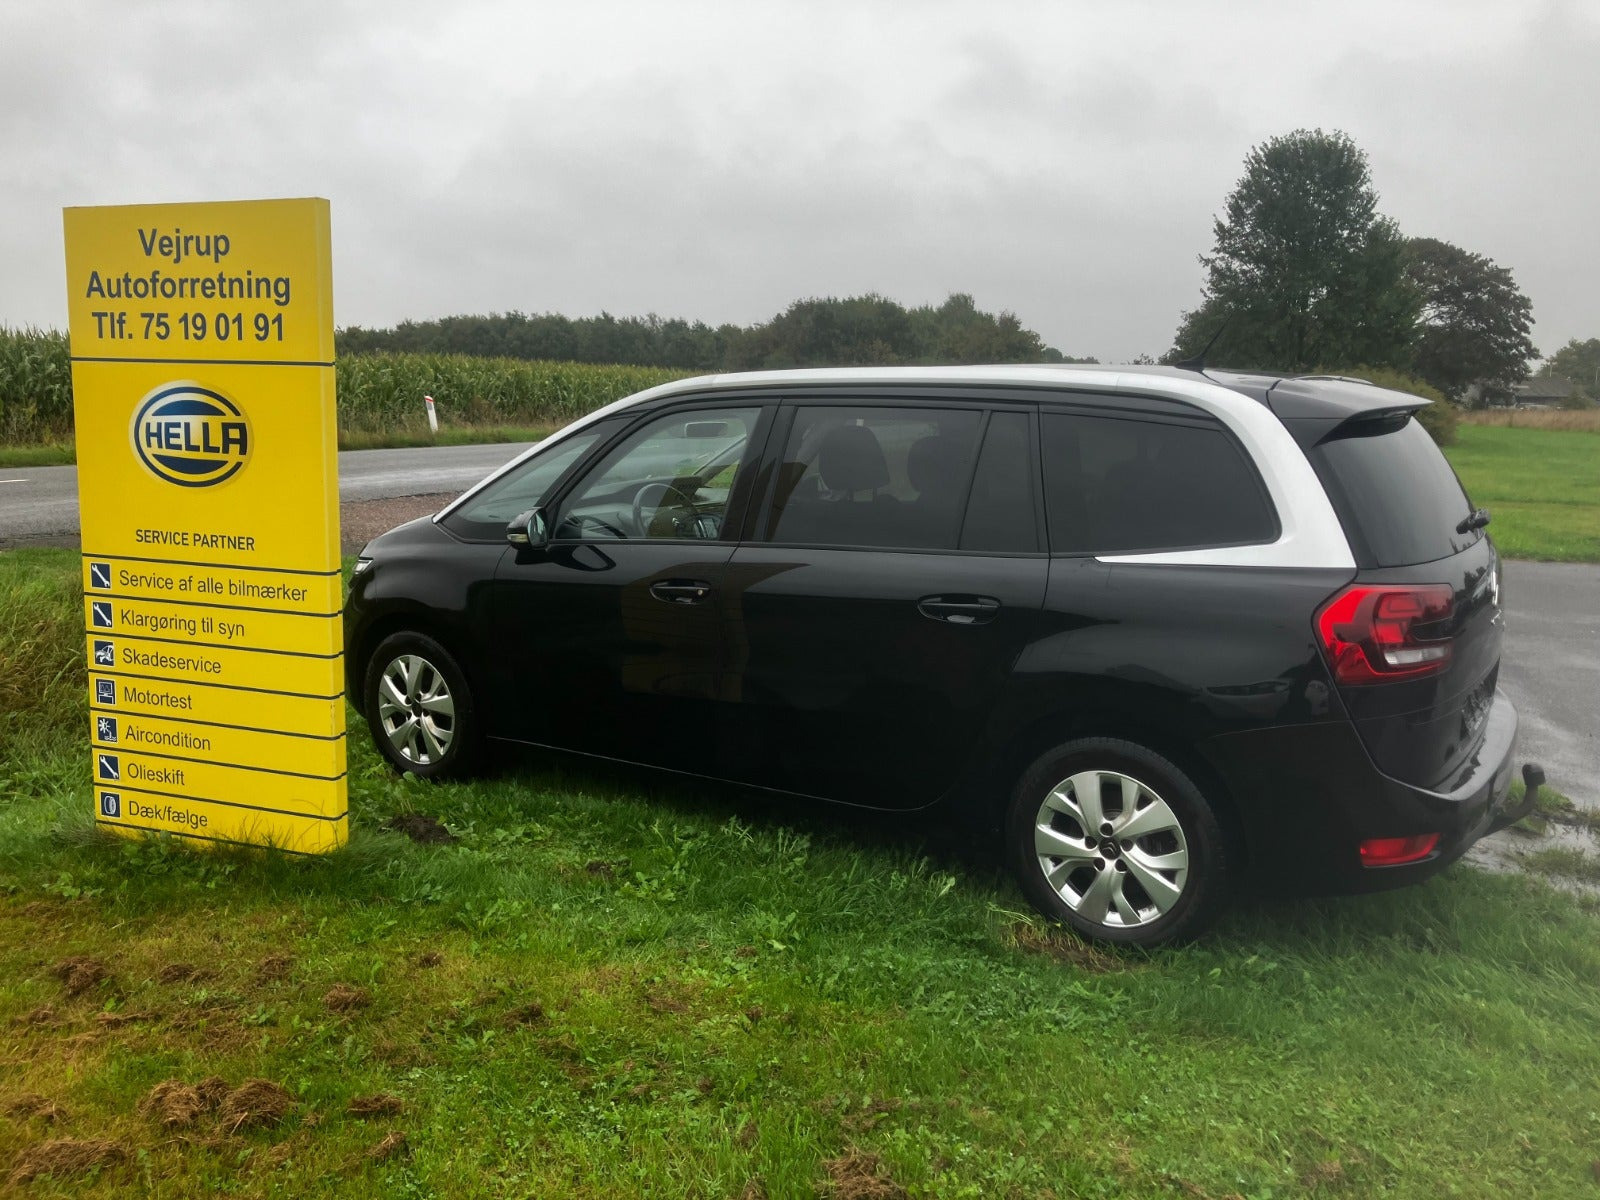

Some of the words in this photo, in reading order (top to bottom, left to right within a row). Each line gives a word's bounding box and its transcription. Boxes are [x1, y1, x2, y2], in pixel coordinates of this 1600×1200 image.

[138, 228, 230, 264] Vejrup
[86, 270, 290, 306] Autoforretning
[92, 312, 133, 340] Tlf.
[141, 313, 170, 340] 75
[178, 313, 207, 341] 19
[215, 313, 243, 341] 01
[254, 313, 283, 341] 91
[146, 422, 248, 456] HELLA
[135, 529, 189, 546] SERVICE
[193, 533, 255, 551] PARTNER
[119, 570, 174, 590] Service
[178, 576, 193, 591] af
[197, 577, 224, 594] alle
[229, 579, 307, 602] bilmærker
[121, 609, 196, 635] Klargøring
[201, 617, 213, 633] til
[218, 620, 245, 639] syn
[122, 648, 221, 674] Skadeservice
[124, 686, 192, 710] Motortest
[125, 724, 211, 750] Aircondition
[127, 763, 185, 785] Olieskift
[129, 800, 208, 829] Dæk/fælge
